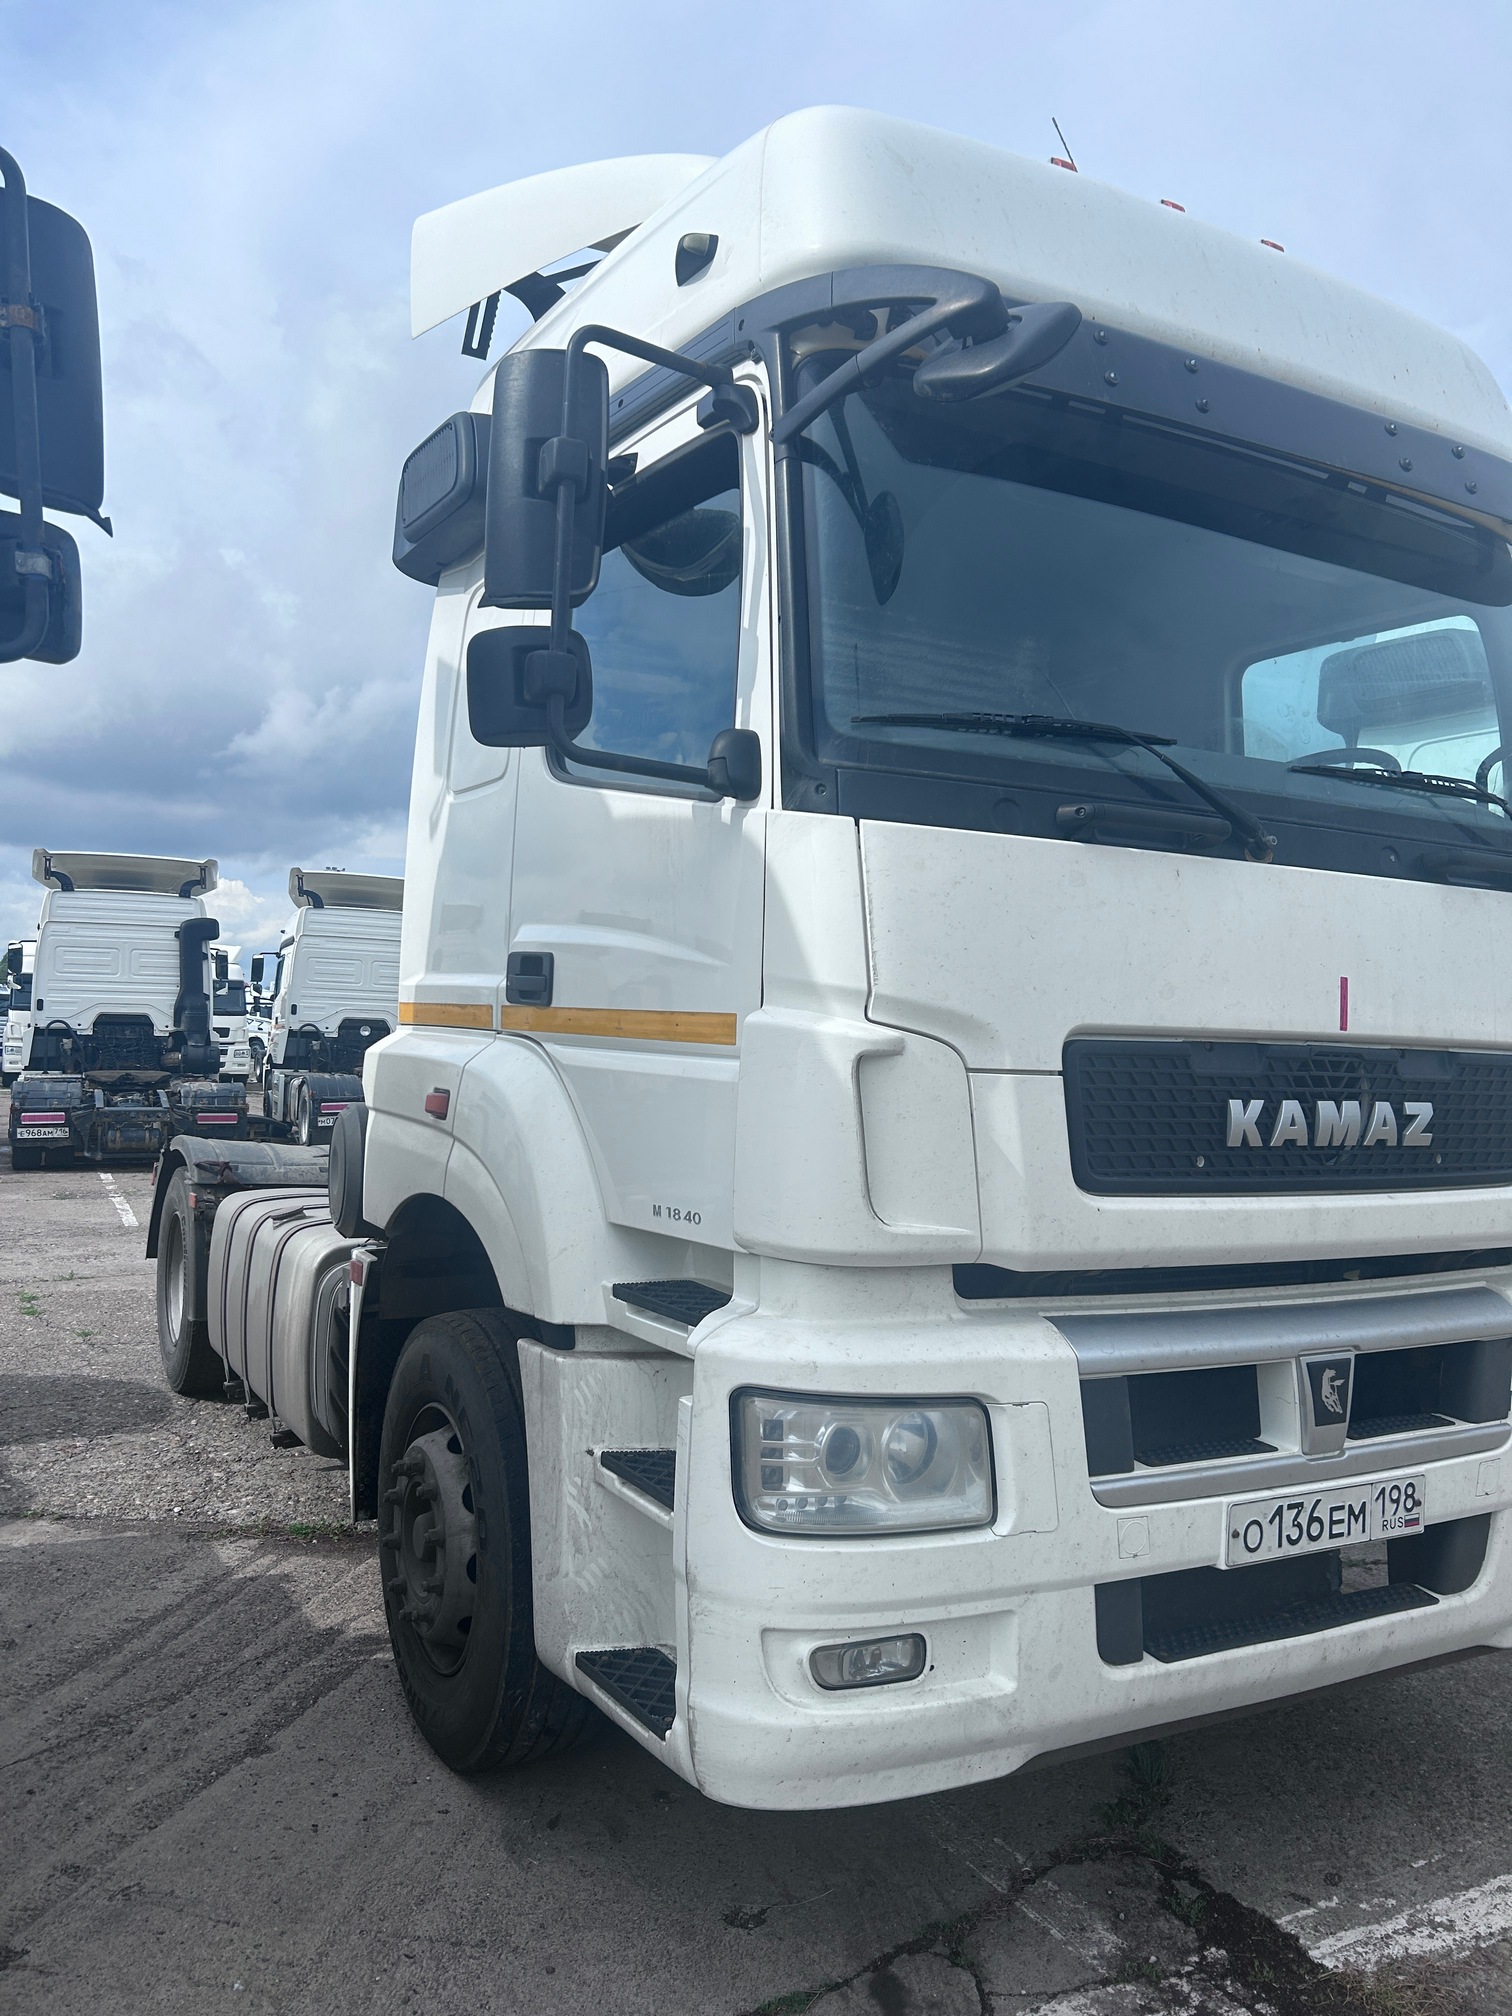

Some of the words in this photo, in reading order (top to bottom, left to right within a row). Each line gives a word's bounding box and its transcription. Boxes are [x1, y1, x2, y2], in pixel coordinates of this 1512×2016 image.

[1227, 1099, 1434, 1147] KAMAZ
[652, 1203, 662, 1218] M
[1243, 1498, 1367, 1553] O136EM
[1374, 1481, 1416, 1519] 198
[1381, 1516, 1404, 1532] RUS
